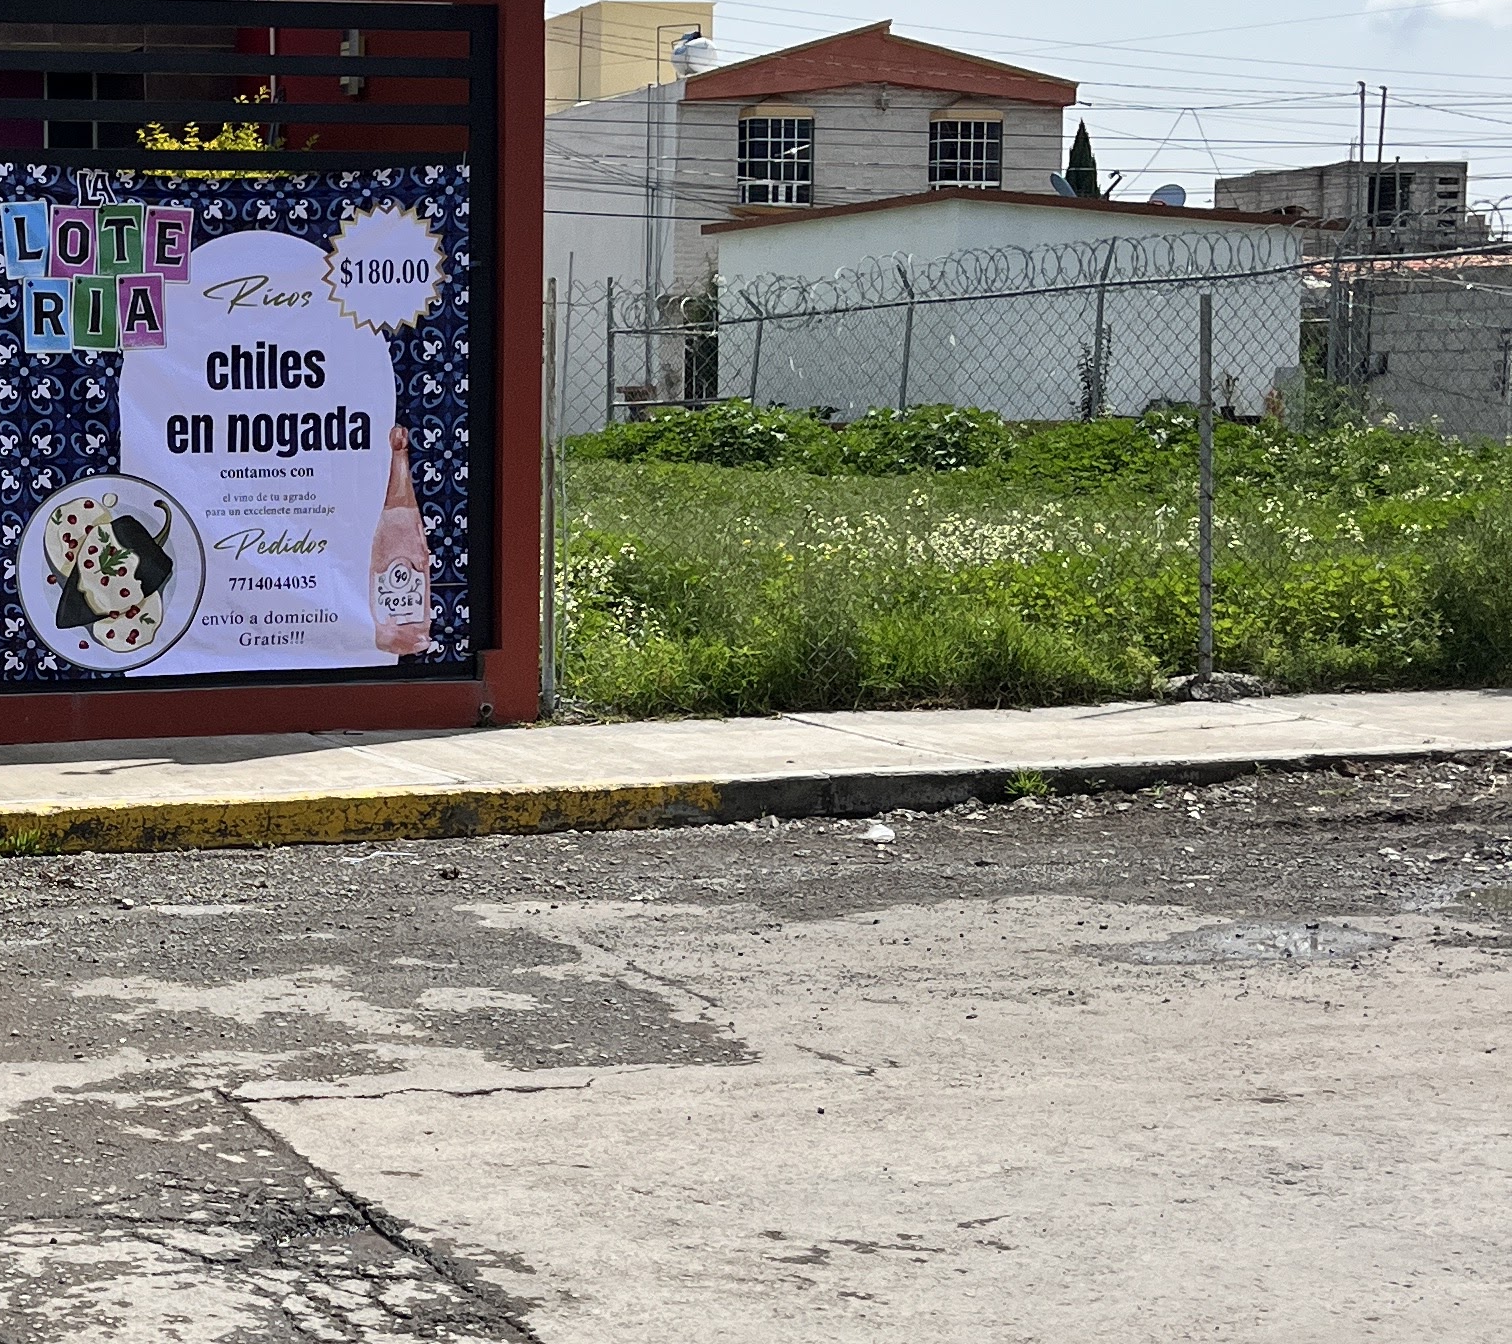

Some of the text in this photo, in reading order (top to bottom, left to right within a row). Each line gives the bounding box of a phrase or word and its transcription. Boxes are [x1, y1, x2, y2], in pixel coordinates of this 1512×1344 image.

[77, 170, 118, 208] LA
[13, 216, 186, 267] LOTE
[340, 258, 430, 287] $180.00
[203, 275, 313, 315] Ricos
[32, 287, 162, 337] RIA
[206, 341, 326, 391] chiles
[166, 406, 371, 458] en nogada
[220, 466, 314, 479] contamos con
[205, 509, 226, 518] para
[293, 505, 336, 517] maridaje
[222, 491, 317, 503] el vino de tu agrado
[213, 528, 328, 560] Pedidos
[228, 575, 317, 591] 7714044035
[201, 608, 339, 626] envío a domicilio
[239, 630, 305, 647] Gratis!!!
